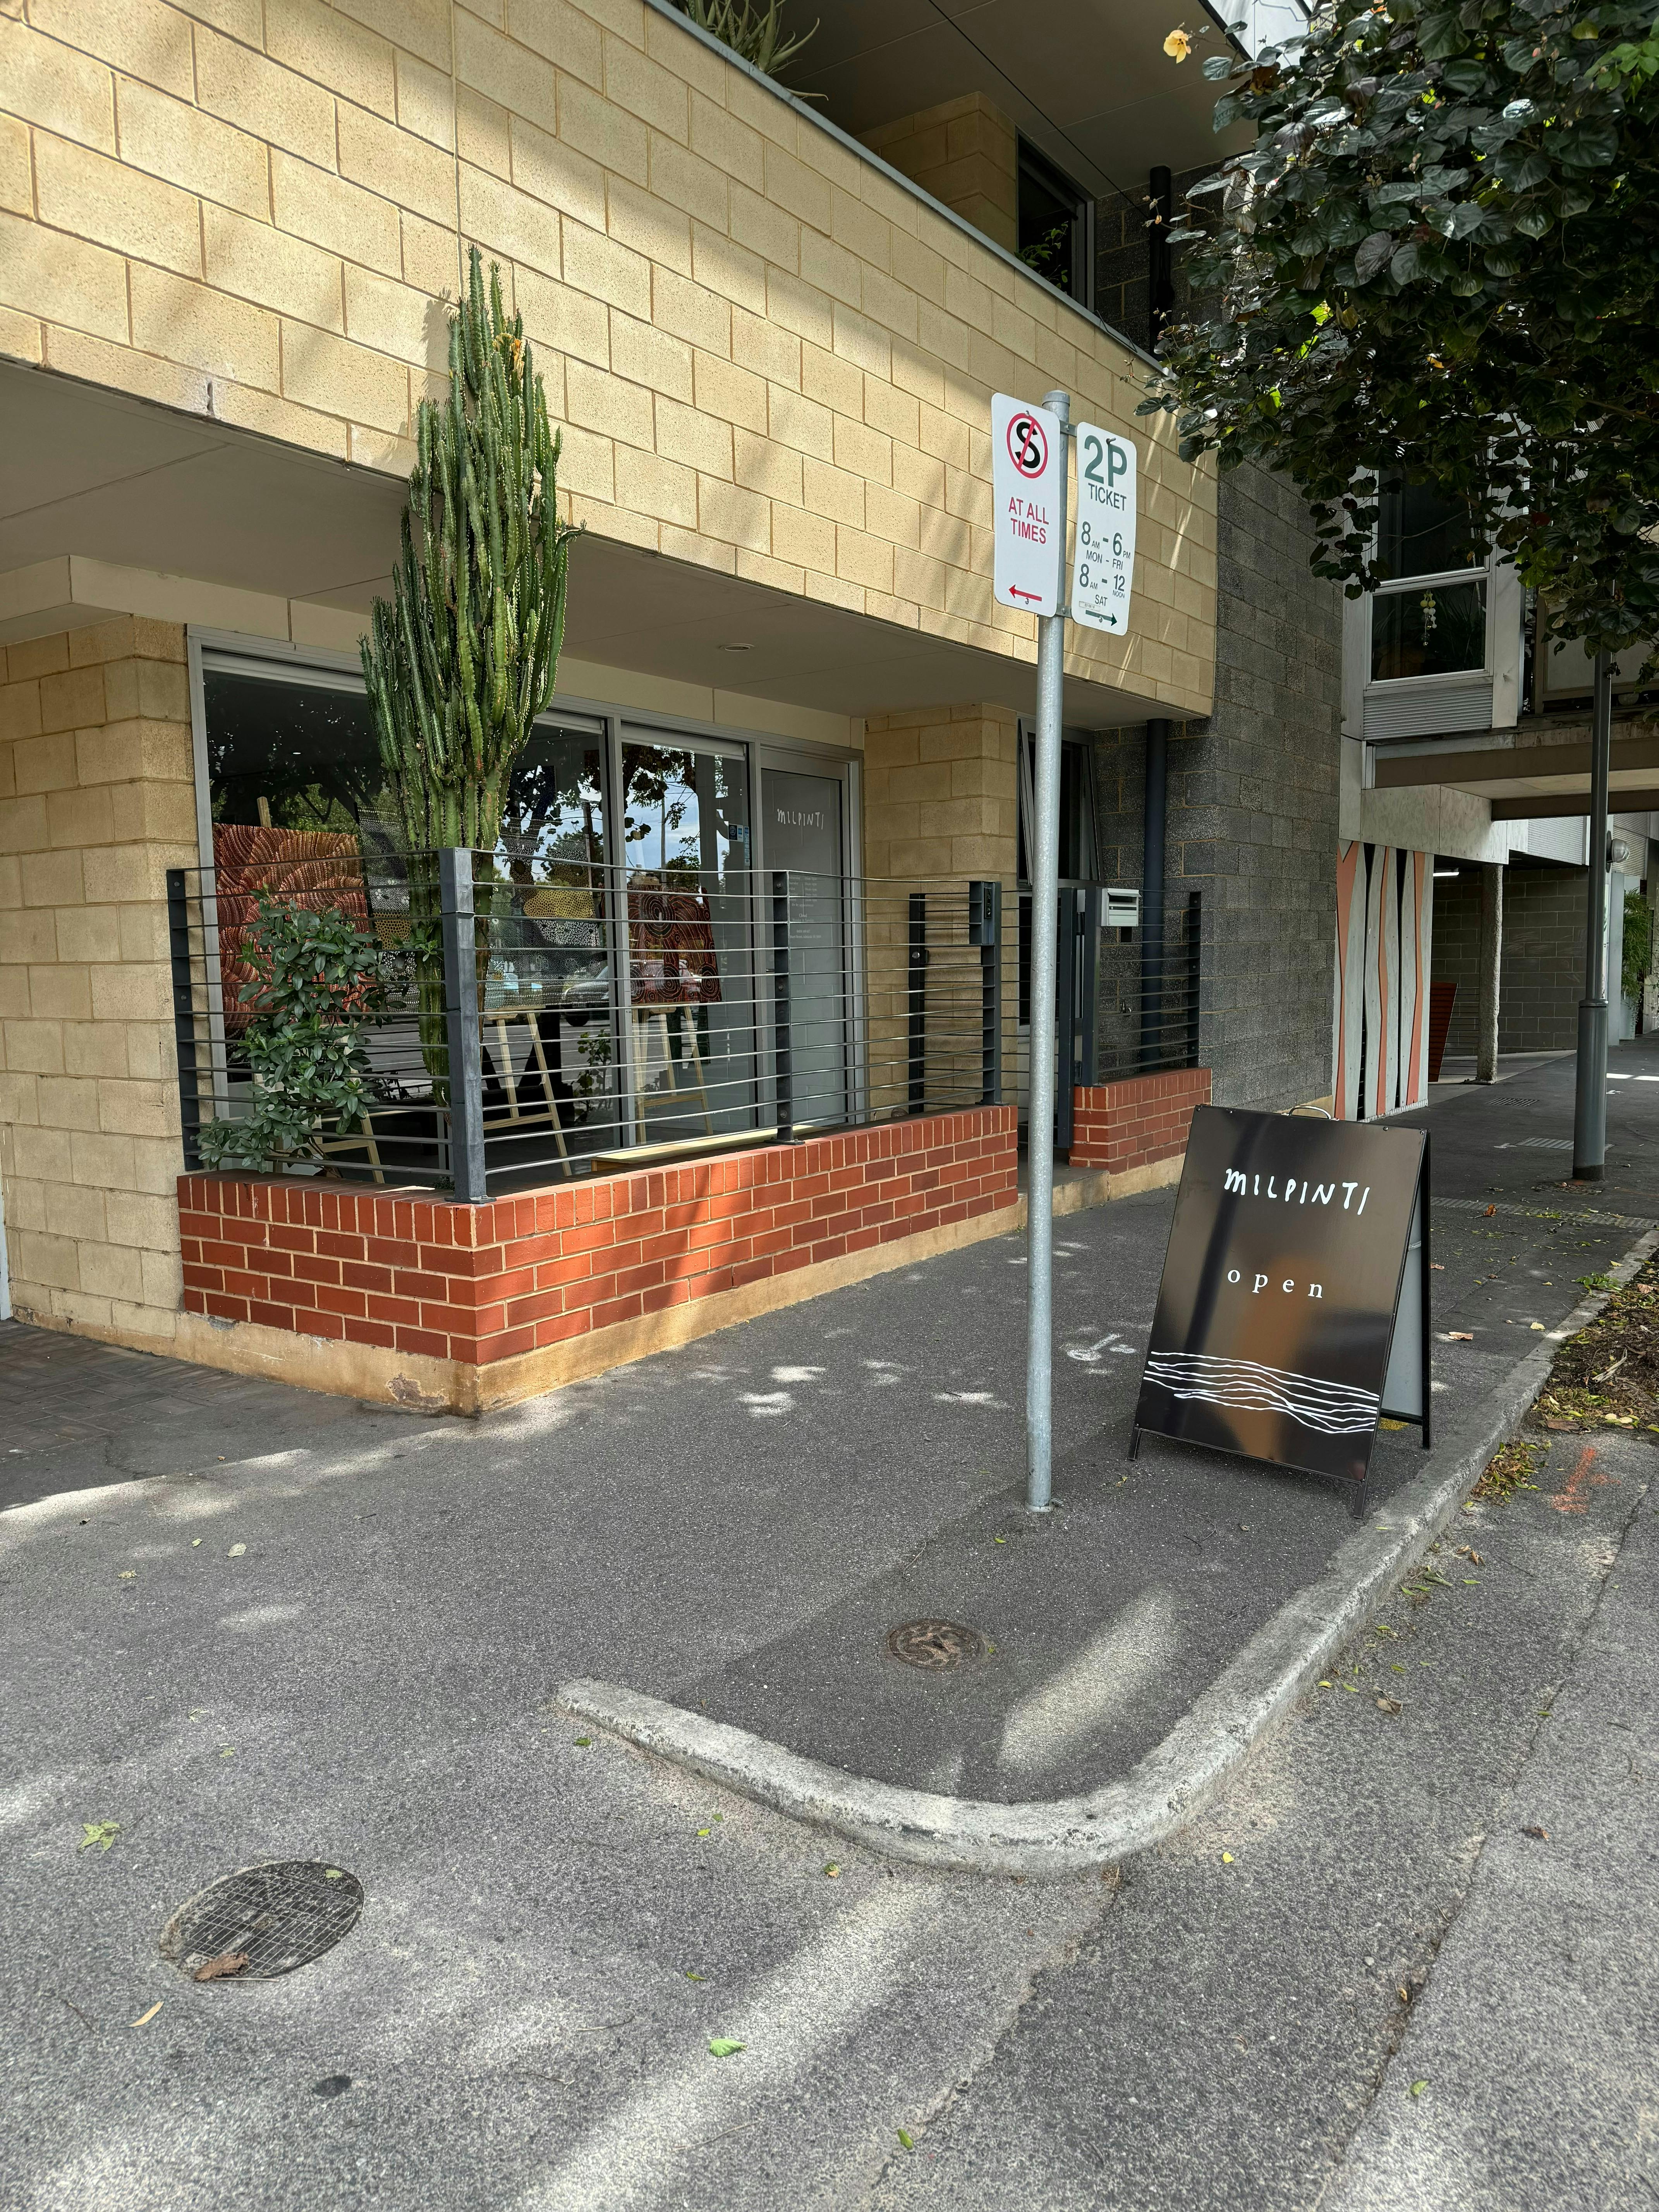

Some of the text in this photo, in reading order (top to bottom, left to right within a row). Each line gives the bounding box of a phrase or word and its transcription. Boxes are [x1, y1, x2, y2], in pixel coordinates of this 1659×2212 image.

[1084, 435, 1127, 488] 2P
[1008, 496, 1049, 525] AT ALL
[1088, 483, 1127, 511] TICKET
[1010, 517, 1046, 544] TIMES
[1086, 550, 1103, 564] MON
[1112, 558, 1123, 570] FRI
[1113, 590, 1125, 599] NOON
[1114, 574, 1125, 592] 12
[1095, 594, 1108, 607] SAT
[777, 809, 824, 830] MILPINTI
[1224, 1168, 1370, 1216] MILPINTI
[1227, 1269, 1323, 1298] open
